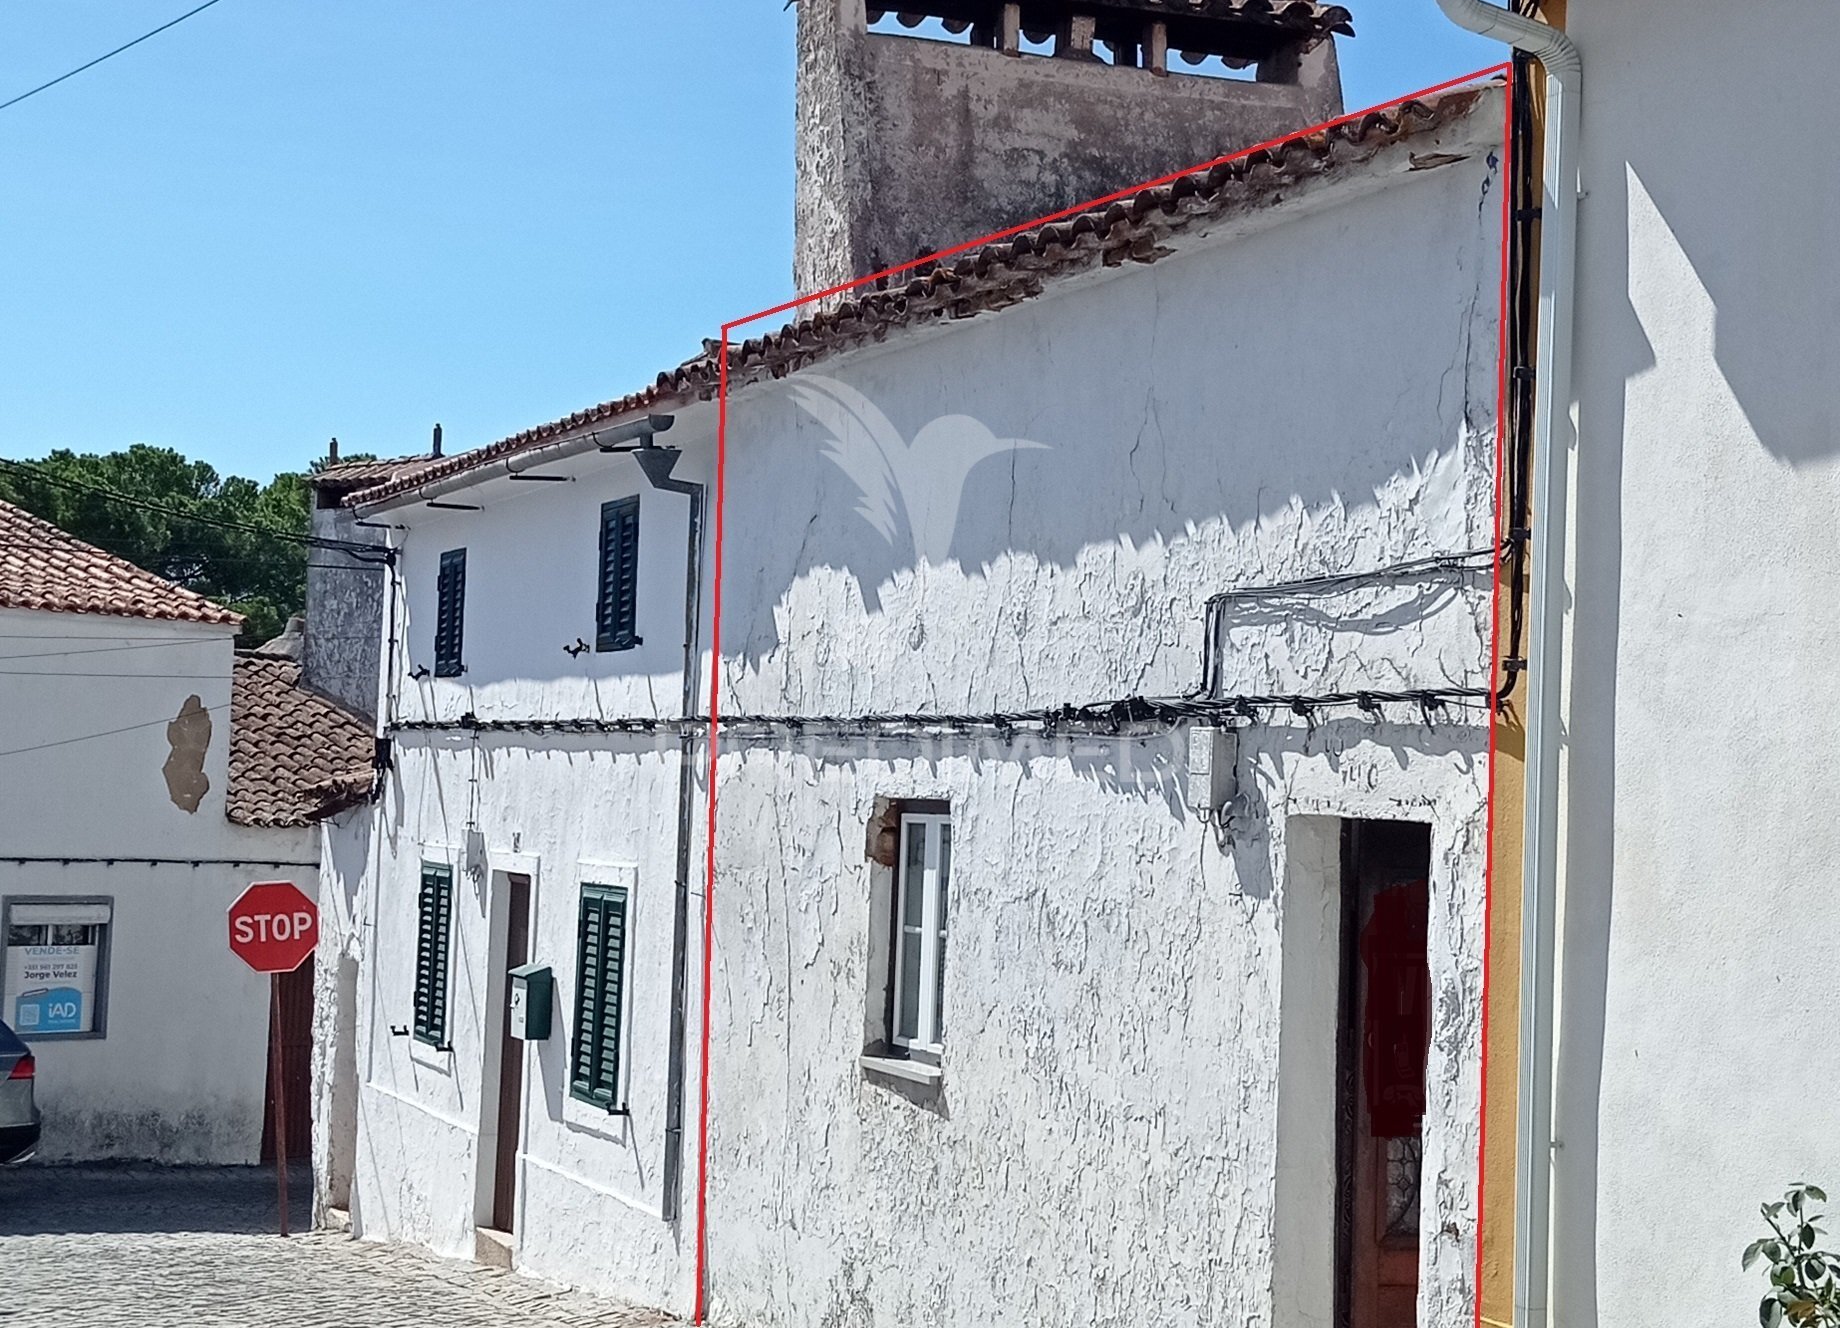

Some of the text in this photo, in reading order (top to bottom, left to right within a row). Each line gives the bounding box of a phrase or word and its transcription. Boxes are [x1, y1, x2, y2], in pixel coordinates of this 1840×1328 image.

[235, 912, 312, 943] STOP
[24, 947, 80, 955] VENDE-SE
[24, 970, 78, 980] Jorge Velez
[48, 1002, 76, 1018] iAD
